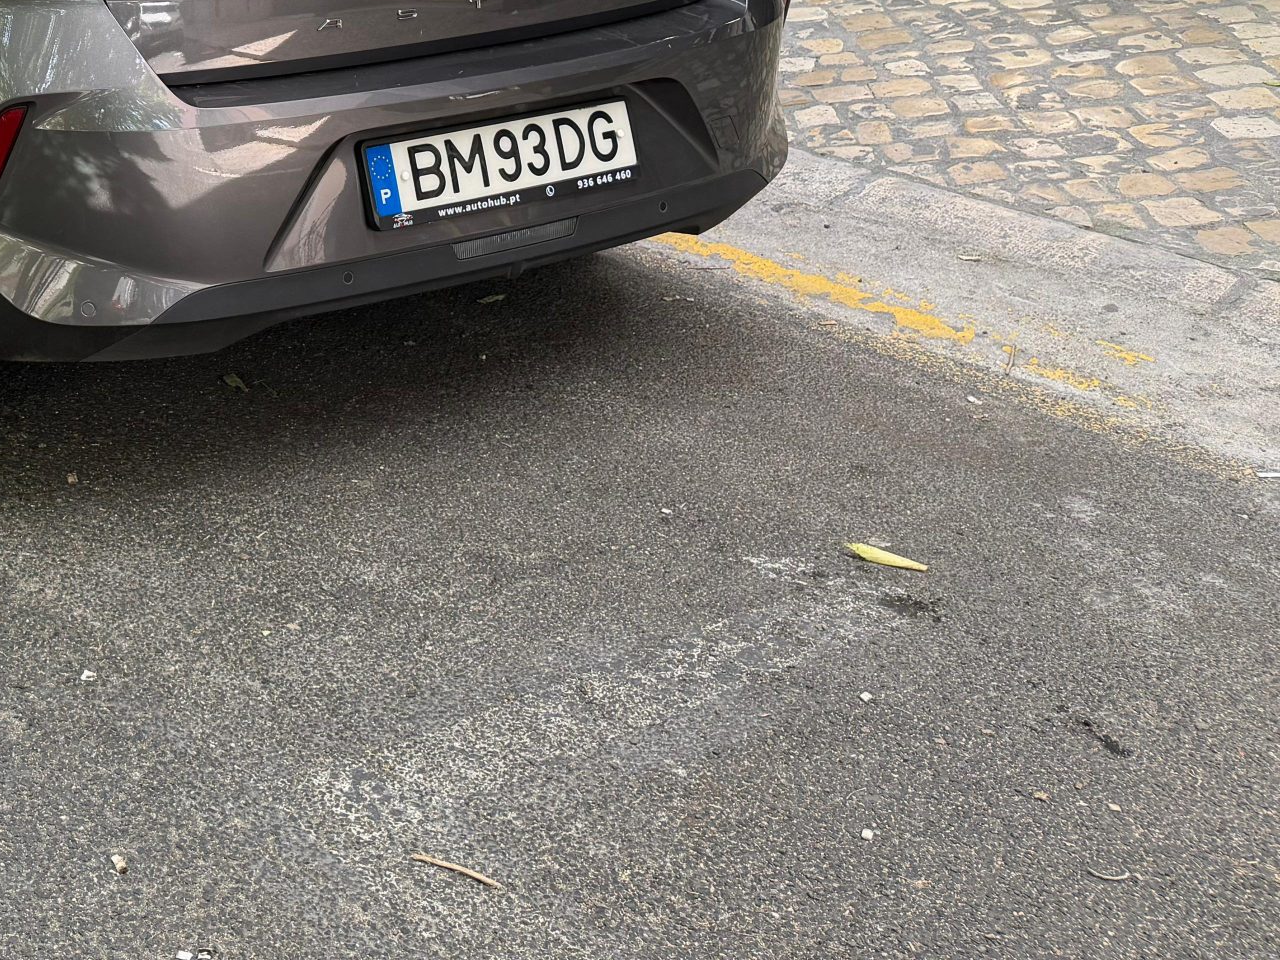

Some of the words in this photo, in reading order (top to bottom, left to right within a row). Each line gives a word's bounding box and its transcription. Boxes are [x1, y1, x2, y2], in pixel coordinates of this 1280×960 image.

[407, 110, 619, 202] BM93DG
[577, 176, 594, 189] 936
[596, 173, 613, 186] 646
[615, 169, 632, 182] 460
[380, 188, 392, 205] P
[437, 193, 521, 217] www.autohub.pt
